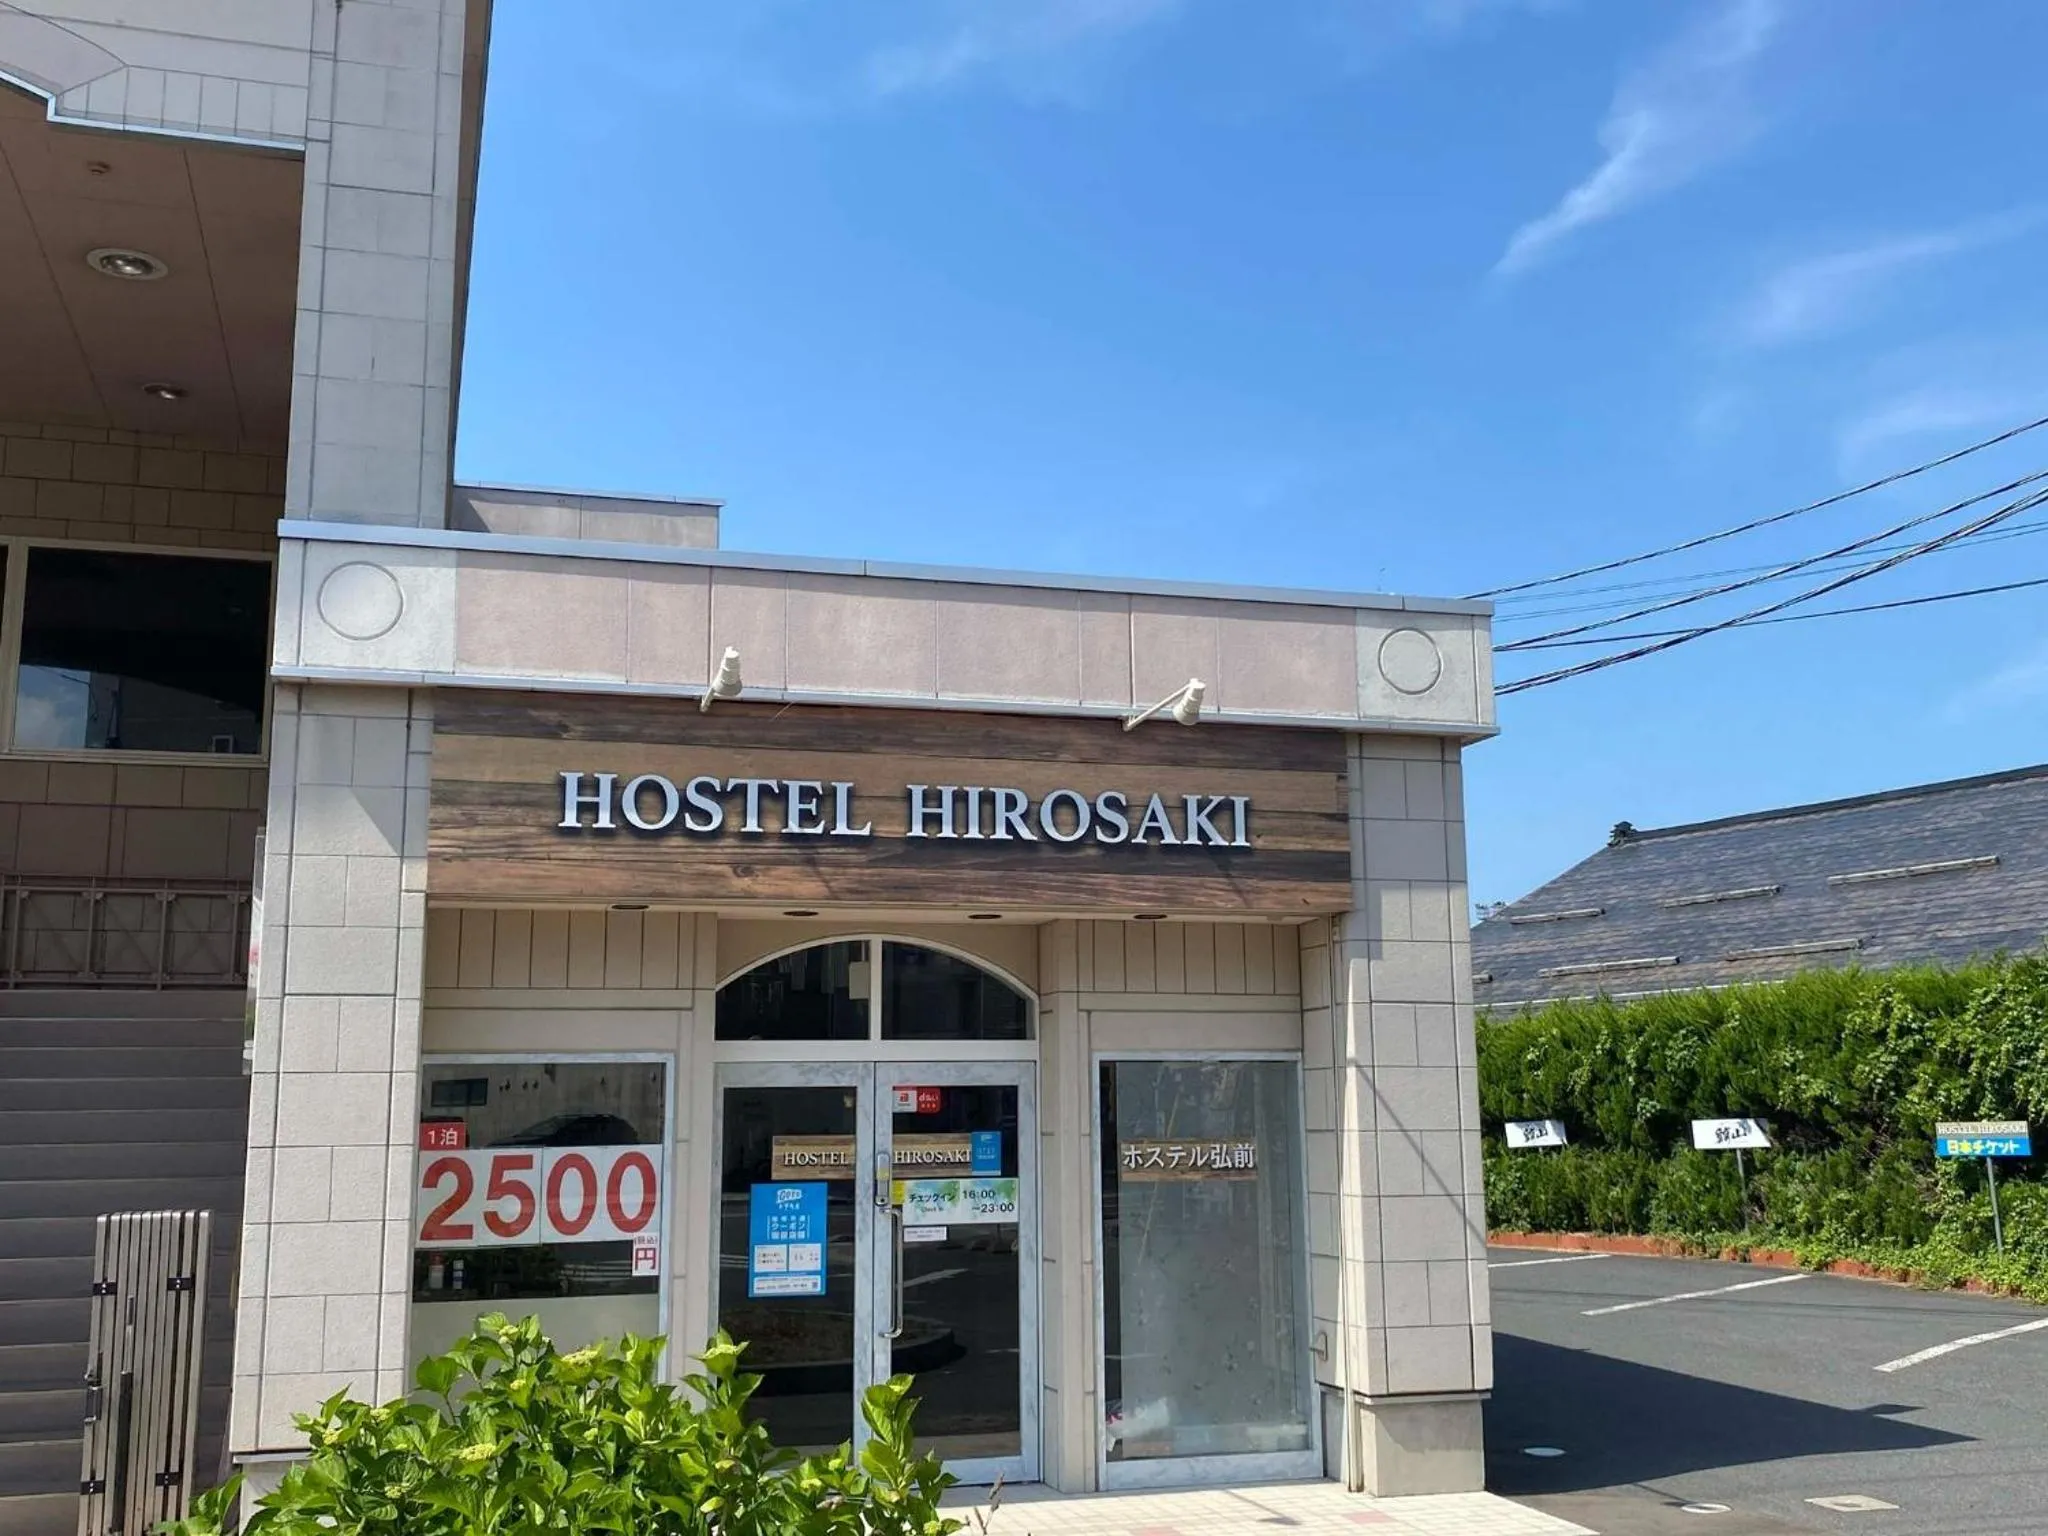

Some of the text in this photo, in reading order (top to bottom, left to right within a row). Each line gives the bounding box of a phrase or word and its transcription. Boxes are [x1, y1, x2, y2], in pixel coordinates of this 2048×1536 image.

[557, 771, 1252, 847] HOSTEL HIROSAKI
[428, 1129, 458, 1146] 1泊
[784, 1151, 849, 1166] HOSTEL
[894, 1149, 970, 1164] HIROSAKI
[1123, 1143, 1255, 1169] ホステル弘前
[420, 1151, 657, 1241] 2500
[963, 1189, 996, 1200] 16:00
[635, 1247, 657, 1270] 円
